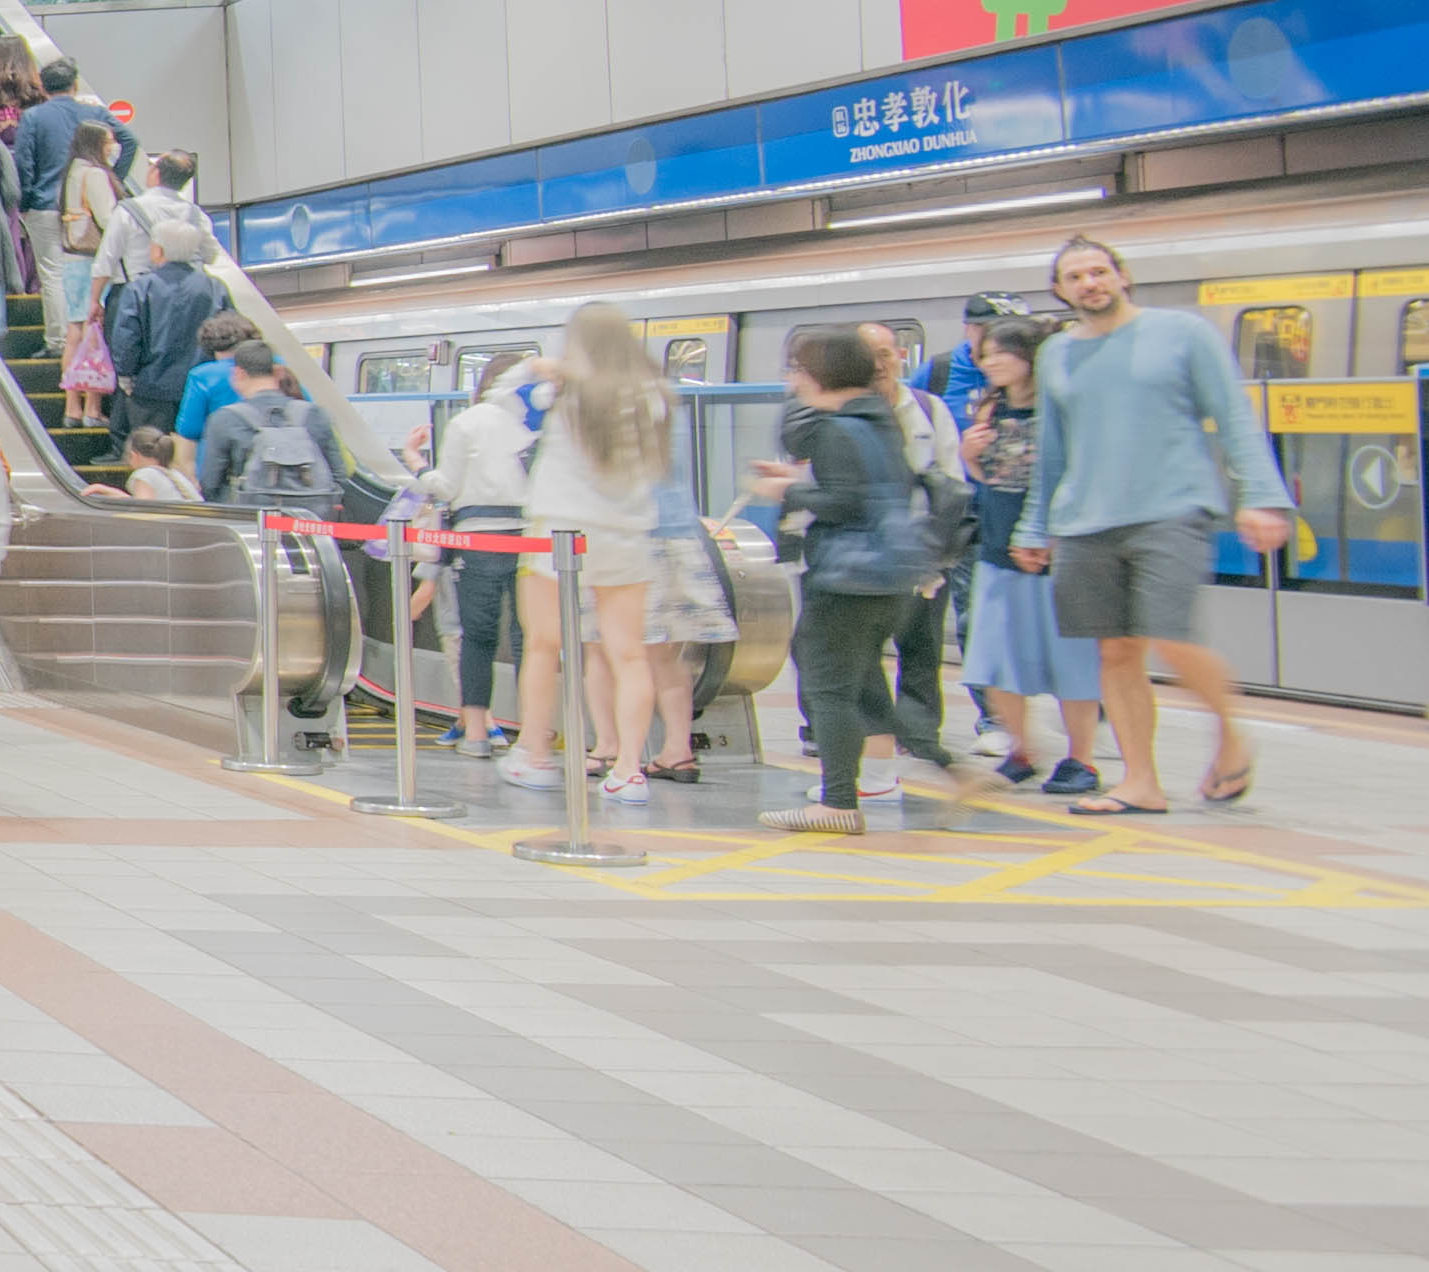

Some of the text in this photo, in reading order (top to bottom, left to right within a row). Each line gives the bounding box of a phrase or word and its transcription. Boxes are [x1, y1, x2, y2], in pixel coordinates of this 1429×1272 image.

[853, 80, 972, 137] 忠孝敦化
[849, 129, 978, 163] ZHONGXIAO DUNHUA
